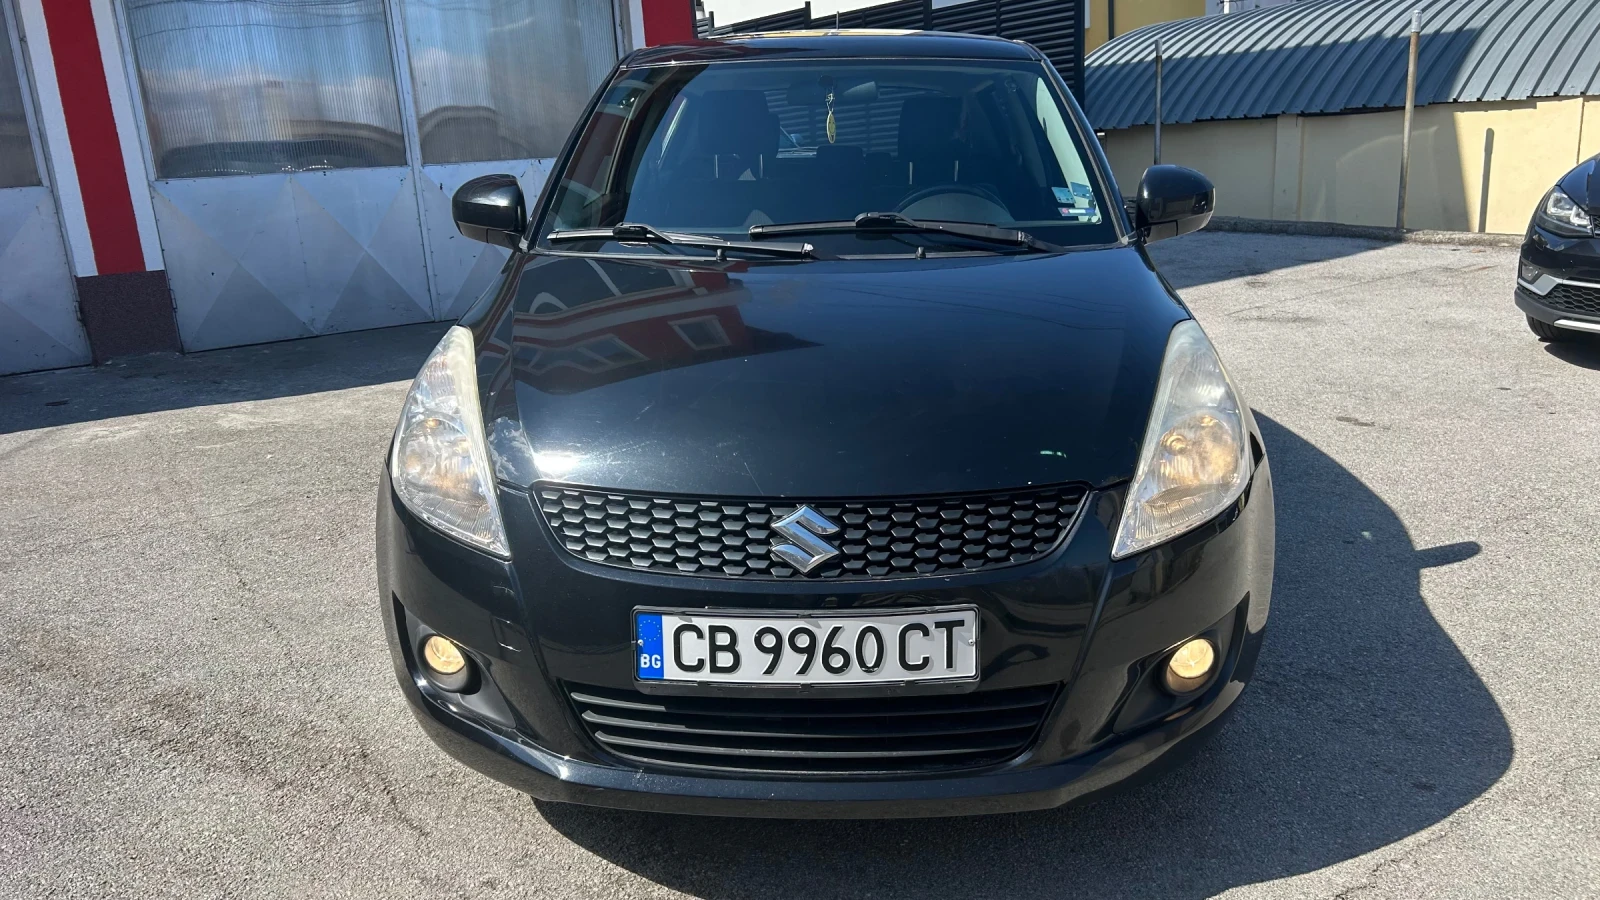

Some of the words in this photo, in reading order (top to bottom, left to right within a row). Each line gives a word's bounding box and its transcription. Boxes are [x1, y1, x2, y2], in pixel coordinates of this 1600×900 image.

[640, 653, 661, 669] BG
[672, 623, 741, 674] CB
[753, 625, 885, 675] 9960
[898, 619, 965, 672] CT
